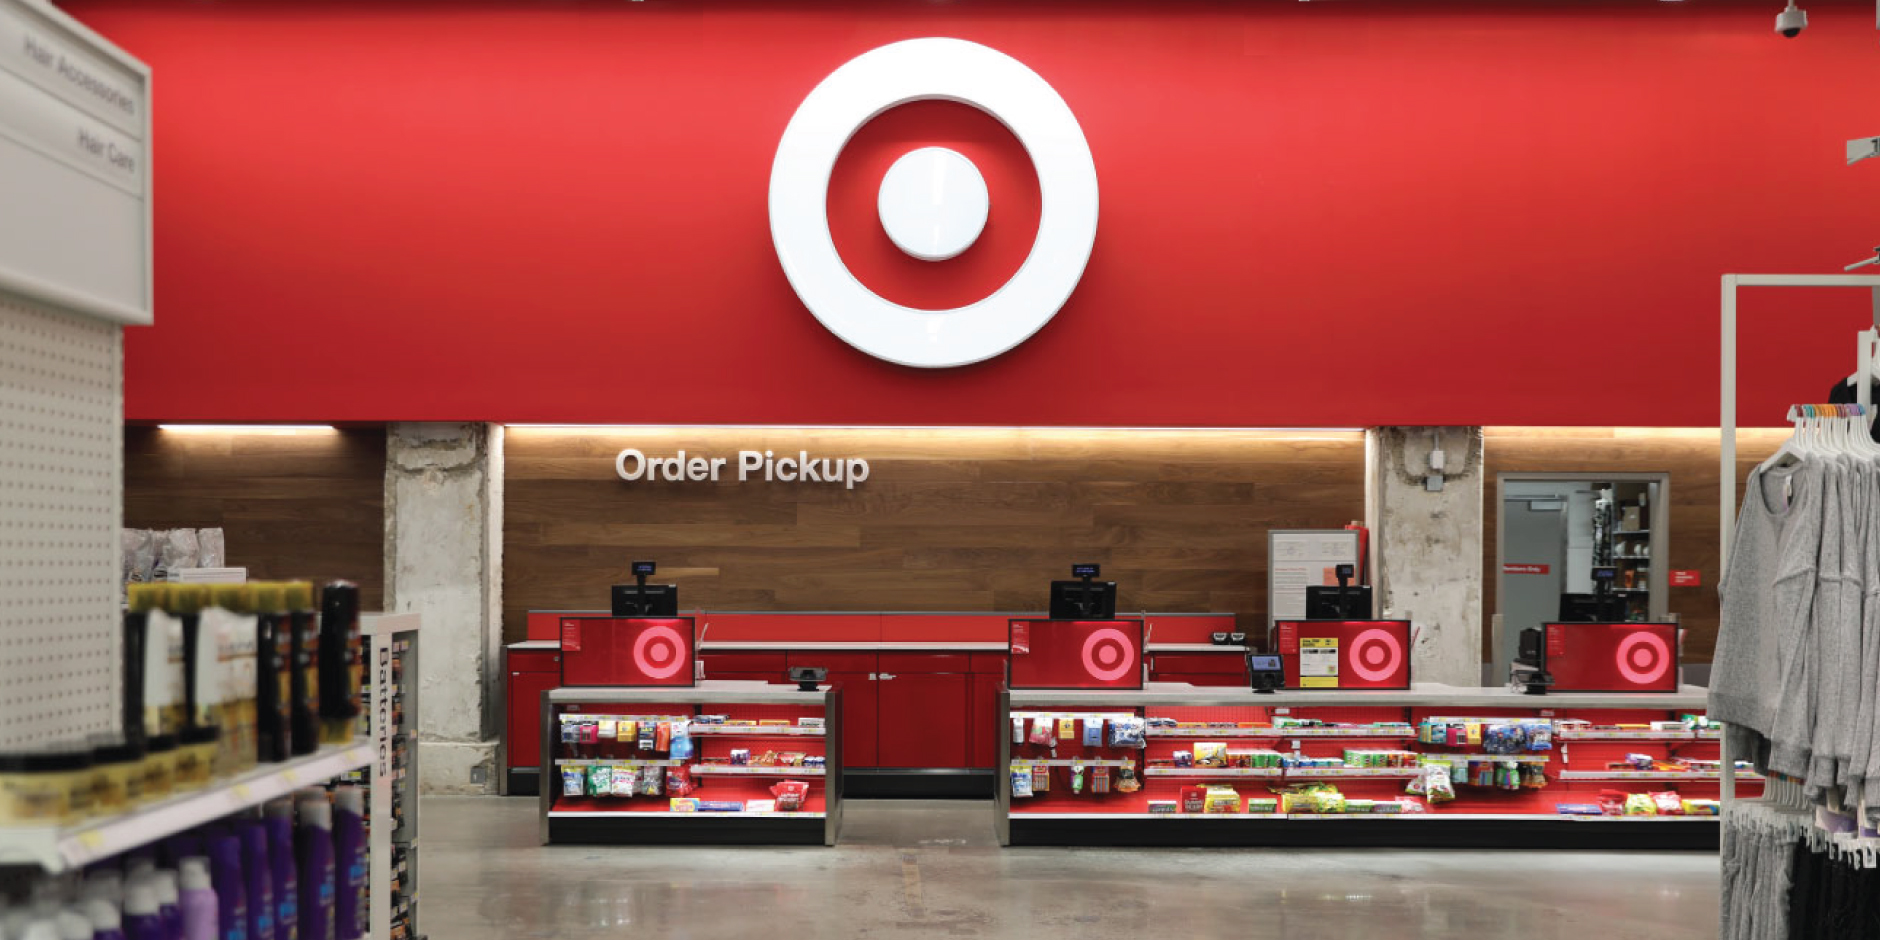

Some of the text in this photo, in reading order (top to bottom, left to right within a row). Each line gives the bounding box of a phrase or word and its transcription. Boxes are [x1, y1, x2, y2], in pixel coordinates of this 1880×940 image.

[24, 35, 135, 117] Hair Accessories
[78, 127, 135, 173] Hair Care
[615, 448, 869, 490] Order Pickup
[379, 647, 388, 777] Batteries
